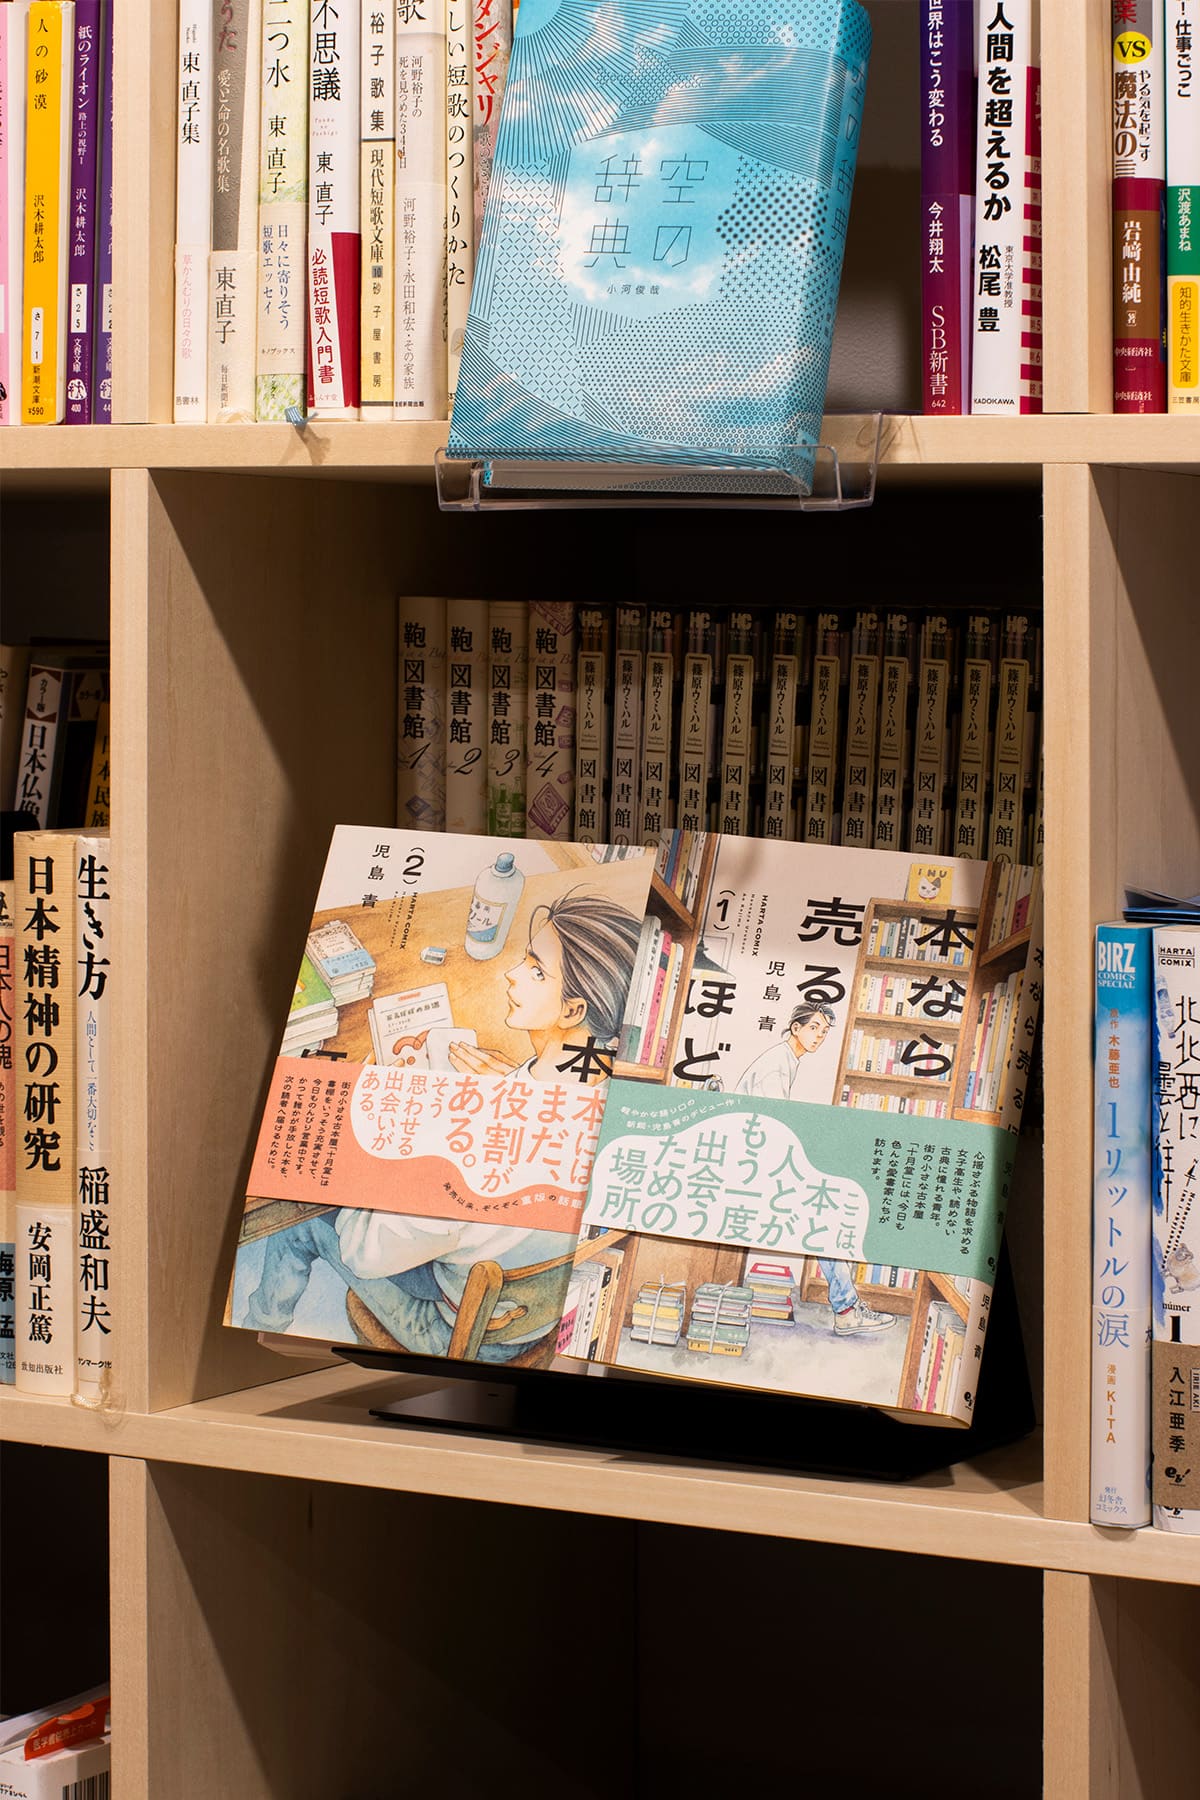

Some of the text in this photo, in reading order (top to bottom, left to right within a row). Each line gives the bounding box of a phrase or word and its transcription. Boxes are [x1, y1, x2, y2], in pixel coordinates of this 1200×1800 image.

[397, 0, 427, 24] 歌
[34, 18, 49, 110] 人の砂漠
[78, 25, 93, 109] 紙のライオン
[313, 0, 341, 101] 不思議
[370, 12, 385, 132] 裕子歌集
[411, 55, 423, 118] 河野裕子の
[475, 0, 500, 127] タンジャリ
[928, 0, 945, 147] 世界はこう変わる
[1117, 41, 1146, 58] VS
[182, 52, 200, 144] 東直子集
[983, 2, 1015, 223] 人間を超えるか
[267, 115, 287, 194] 東直子
[316, 152, 334, 226] 東直子
[32, 193, 45, 264] 沢木耕太郎
[74, 188, 87, 256] 沢木耕太郎
[370, 149, 385, 262] 現代短歌文庫
[583, 153, 643, 268] 辞典
[653, 154, 709, 267] 空の
[928, 201, 944, 273] 今井翔太
[1177, 188, 1192, 252] 沢渡あまね
[215, 266, 236, 344] 東直子
[263, 225, 274, 315] 短歌エッセイ
[277, 225, 291, 330] 日々に寄りそう
[606, 283, 660, 296] 小河俊哉
[1003, 245, 1015, 309] 東京大学准教授
[312, 248, 335, 384] 必読短歌入門書
[930, 305, 948, 395] SB新書
[1179, 286, 1192, 383] 知的生きかた文庫
[931, 399, 946, 408] 642
[974, 398, 1016, 406] KADOKAWA
[584, 661, 596, 730] 篠原ウミハル
[620, 660, 634, 728] 篠原ウミハル
[650, 662, 664, 732] 篠原ウミハル
[689, 664, 704, 733] 篠原ウミハル
[730, 664, 745, 734] 篠原ウミハル
[774, 664, 788, 735] 篠原ウミハル
[817, 666, 830, 736] 篠原ウミハル
[854, 664, 870, 736] 篠原ウミハル
[885, 666, 899, 738] 篠原ウミハル
[924, 669, 939, 741] 篠原ウミハル
[966, 669, 982, 741] 篠原ウミハル
[1004, 669, 1020, 741] 篠原ウミハル
[404, 742, 431, 769] 1
[454, 748, 482, 775] 2
[496, 750, 520, 776] 3
[536, 751, 558, 778] 4
[78, 854, 111, 1001] 生き方
[752, 894, 768, 956] HARTA COMIX
[797, 896, 866, 1005] 売る
[1098, 941, 1136, 974] BIRZ
[1160, 946, 1194, 956] HARTA
[758, 960, 786, 1032] 児島青
[900, 909, 977, 1077] 本なら
[1098, 972, 1136, 981] COMICS
[1098, 980, 1136, 990] SPECIAL
[1160, 958, 1193, 967] COMIX
[23, 855, 62, 1172] 日本精神の研究
[672, 978, 737, 1082] ほど
[360, 1070, 380, 1120] ある。
[555, 1036, 618, 1083] 本
[371, 1070, 404, 1151] 出会いが
[398, 1074, 428, 1156] 思わせる
[430, 1076, 449, 1118] そう
[445, 1076, 484, 1168] ある。
[526, 1084, 570, 1182] まだ、
[480, 1079, 534, 1193] 役割が
[570, 1090, 608, 1186] 本には
[871, 1138, 886, 1180] 訪れます。
[640, 1134, 687, 1233] ための
[687, 1130, 728, 1236] 出会う
[716, 1113, 767, 1243] もう一度
[758, 1144, 805, 1247] 人とが
[801, 1178, 841, 1252] 本と
[912, 1144, 936, 1220] 街の小さな古本屋
[945, 1148, 968, 1236] 女子高生や、読めない
[960, 1151, 986, 1255] 心揺さぶる物語を求める
[78, 1166, 112, 1335] 稲盛和夫
[836, 1191, 859, 1258] ここは、
[1097, 1102, 1130, 1348] 1リットルの涙
[28, 1222, 54, 1344] 安岡正篤
[1170, 1315, 1182, 1343] 1
[1106, 1390, 1116, 1444] KITA
[1169, 1367, 1186, 1453] 入江亜季
